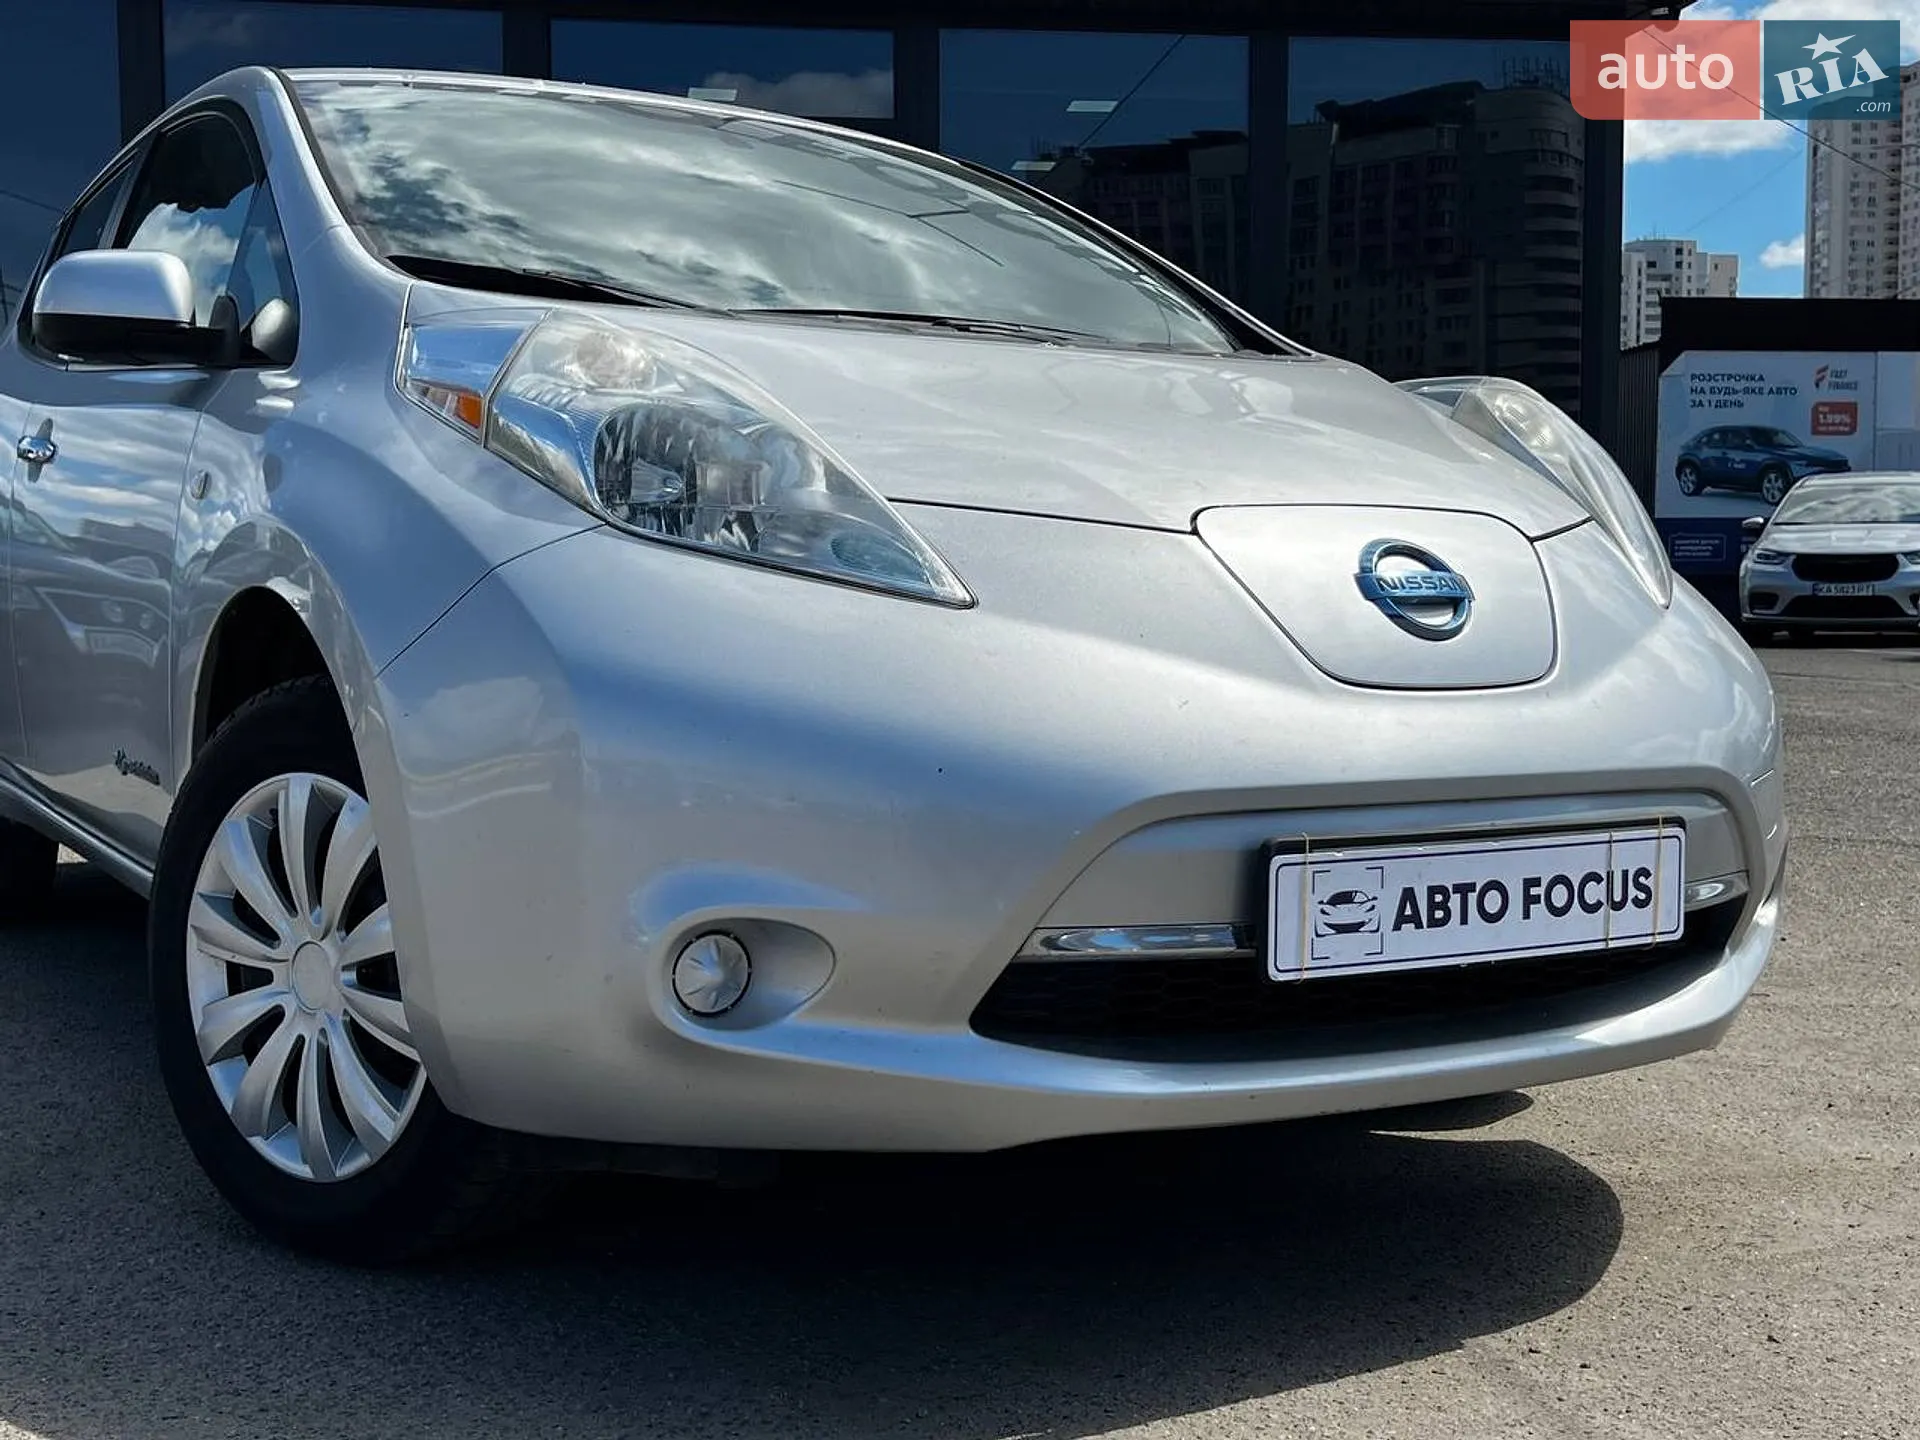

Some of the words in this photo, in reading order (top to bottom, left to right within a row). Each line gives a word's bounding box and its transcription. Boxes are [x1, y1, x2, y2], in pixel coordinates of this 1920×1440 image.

[1690, 373, 1765, 382] РОЗСТРОЧКА
[1690, 386, 1706, 395] НА
[1767, 386, 1798, 396] АВТО
[1714, 399, 1744, 409] ДЕНЬ
[1374, 575, 1467, 595] NISSAN
[1391, 879, 1510, 932] АВТО
[1522, 866, 1653, 921] FOCUS
